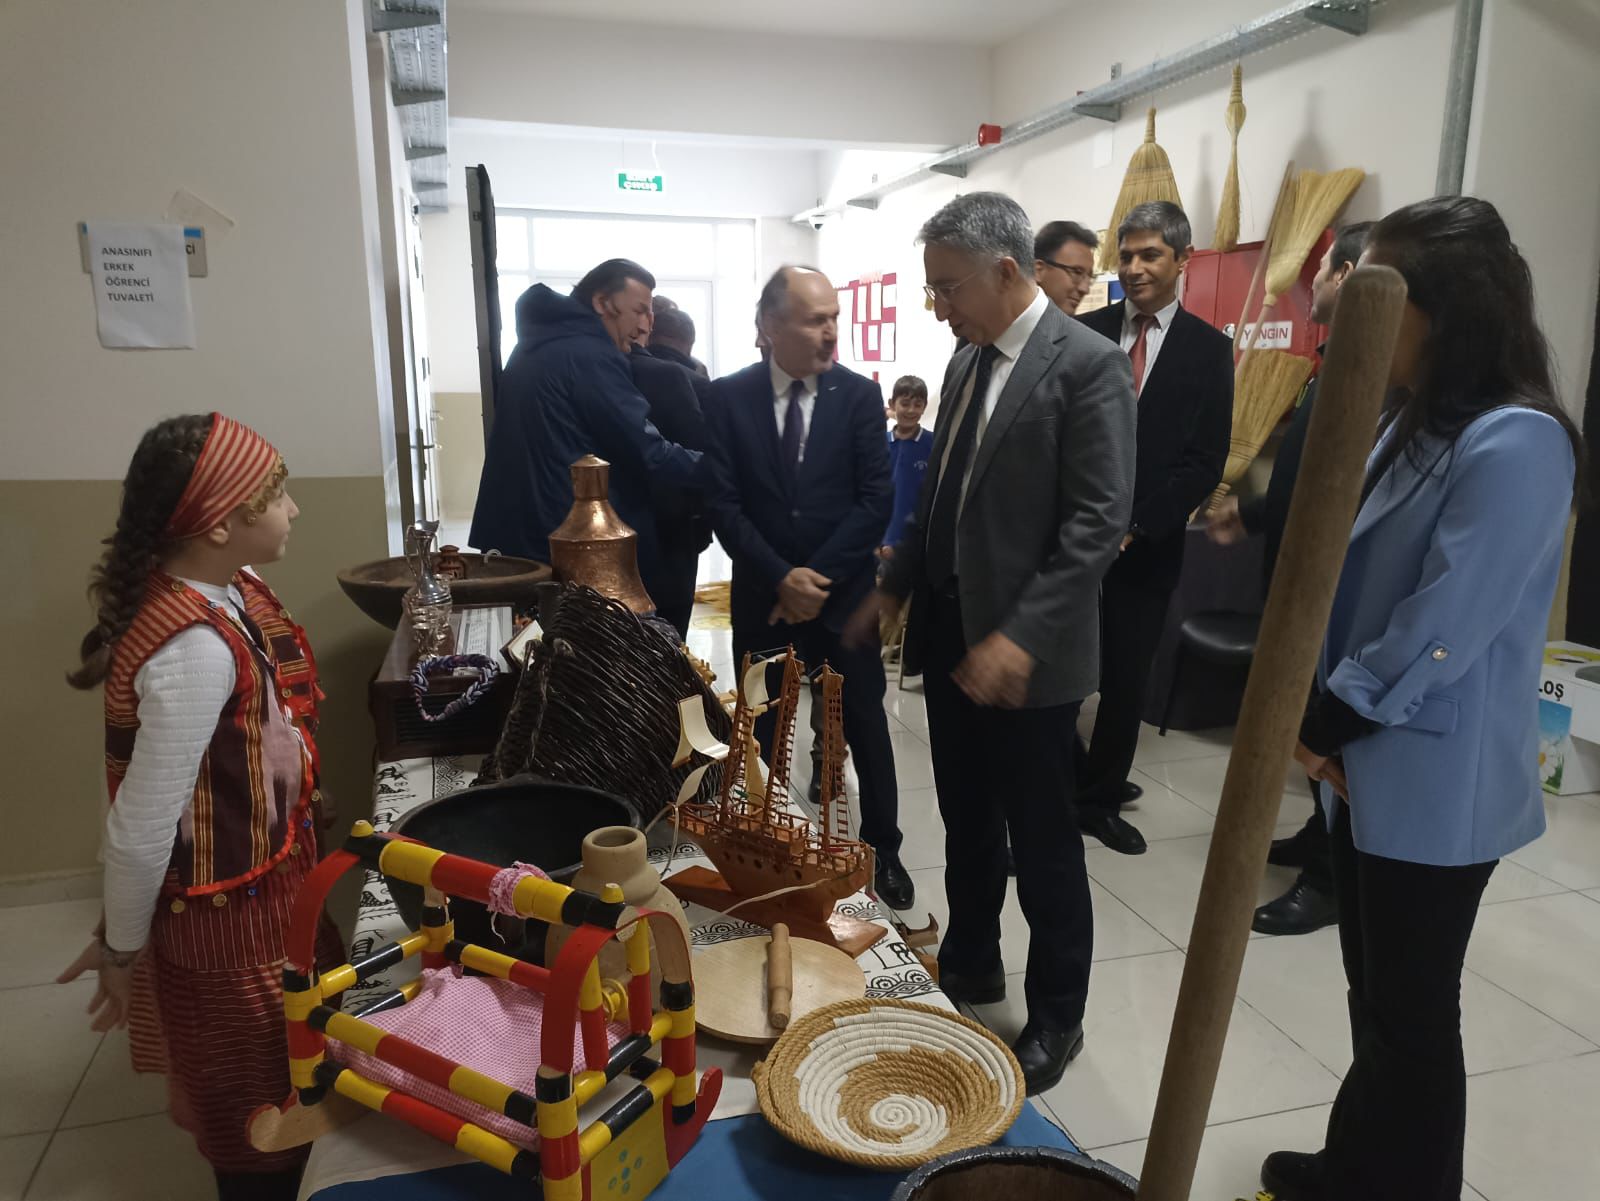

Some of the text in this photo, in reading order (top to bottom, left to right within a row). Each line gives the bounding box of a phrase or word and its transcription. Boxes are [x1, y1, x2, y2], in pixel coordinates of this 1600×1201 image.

[102, 247, 152, 257] ANASINIFI
[103, 262, 135, 271] ERKEK
[105, 276, 150, 287] ÖĞRENCİ
[107, 292, 154, 302] TUVALETİ
[1244, 327, 1289, 340] YNGIN
[1538, 680, 1564, 702] OŞ
